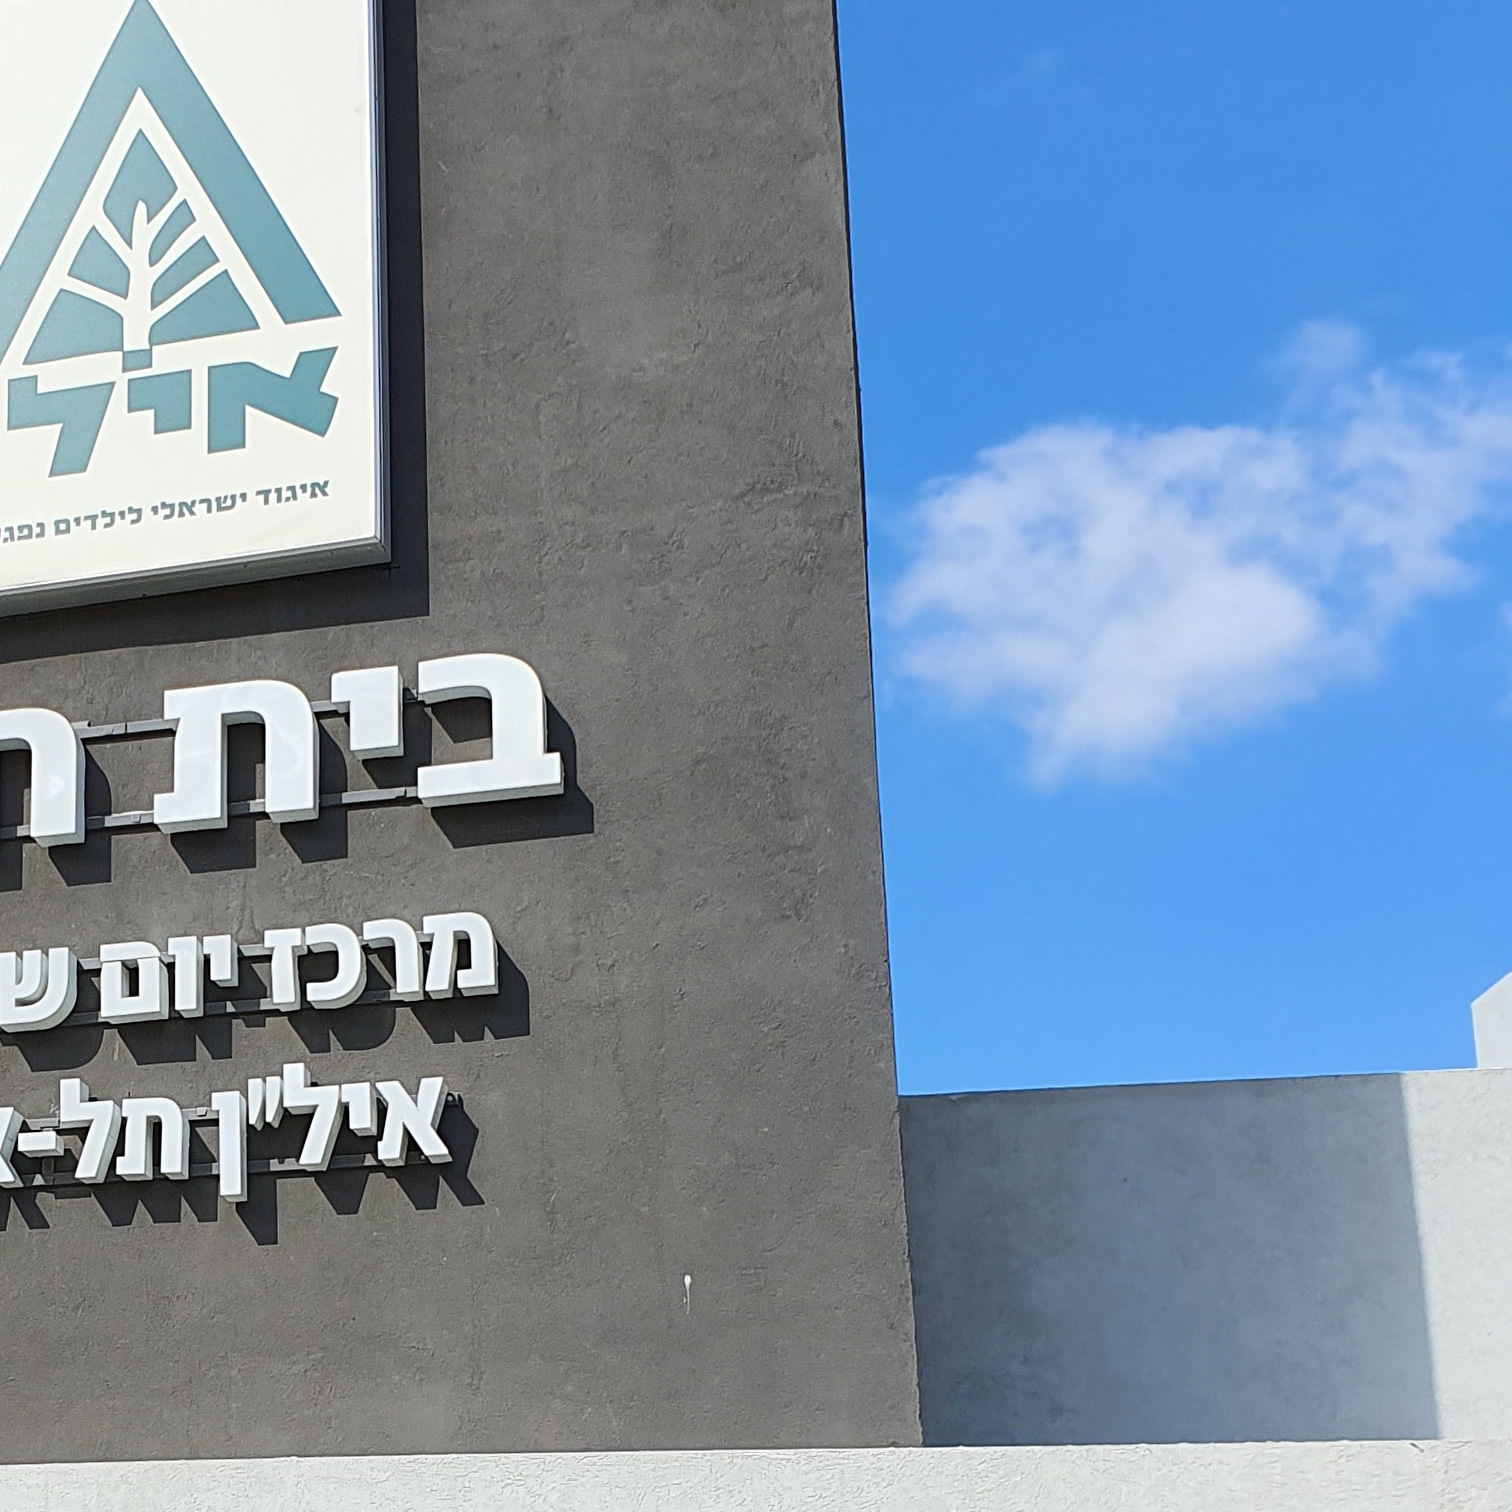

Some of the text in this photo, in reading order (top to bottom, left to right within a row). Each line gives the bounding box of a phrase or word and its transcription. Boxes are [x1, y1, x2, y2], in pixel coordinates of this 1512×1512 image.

[54, 507, 142, 537] לילדים
[151, 492, 247, 519] ישראלי
[256, 480, 329, 507] איגוד
[153, 652, 564, 834] בית
[100, 933, 239, 1024] יום
[264, 911, 498, 1011] מרכז
